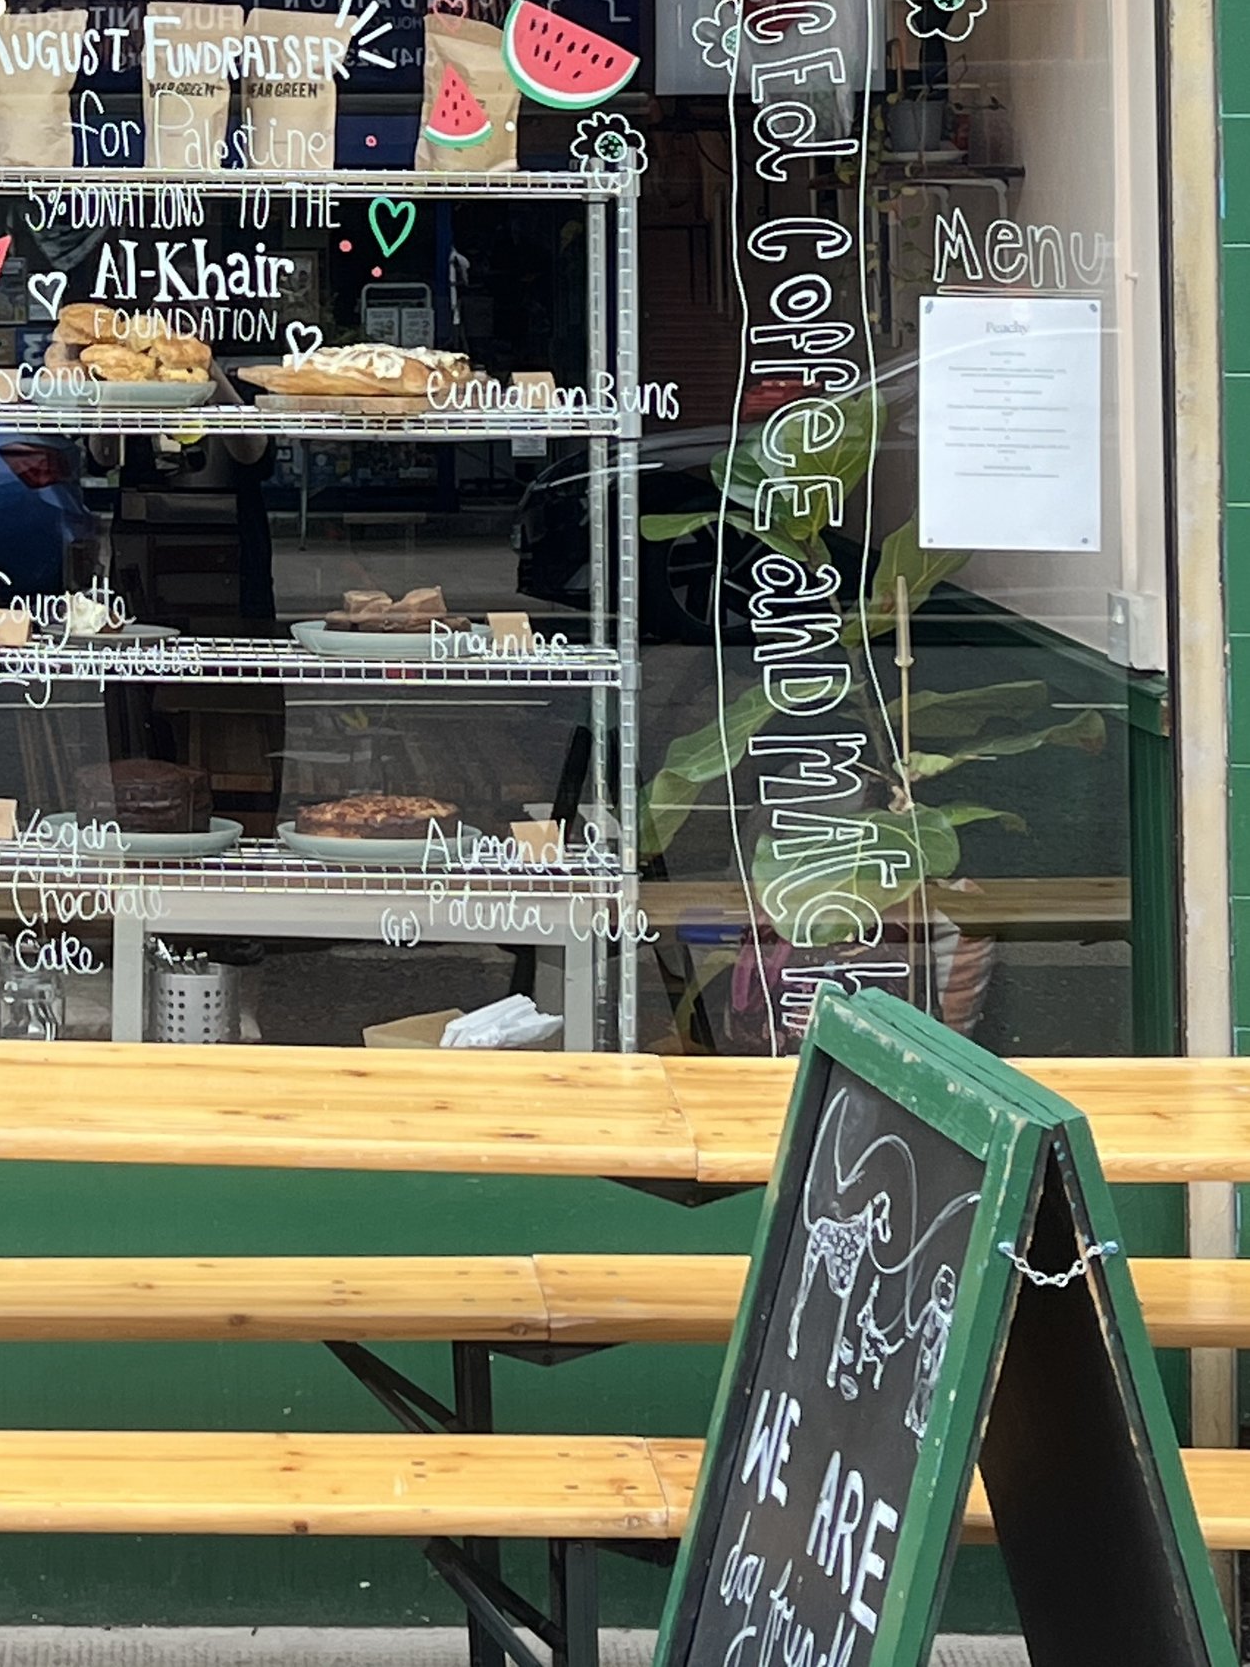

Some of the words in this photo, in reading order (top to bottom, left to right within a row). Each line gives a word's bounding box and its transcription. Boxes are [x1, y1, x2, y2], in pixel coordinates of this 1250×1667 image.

[245, 84, 271, 98] EAR
[63, 90, 141, 167] for
[155, 89, 333, 174] Palestine
[237, 182, 271, 230] TO
[282, 182, 342, 229] THE
[90, 238, 295, 302] Al-Khair
[932, 207, 1105, 289] Menu
[93, 306, 278, 342] FOUNDATION
[426, 370, 588, 416] Cinnamon
[592, 370, 681, 420] Buns
[11, 808, 132, 877] Vegan
[420, 817, 567, 873] Almond
[11, 865, 172, 927] Chocolate
[568, 893, 660, 943] Cake
[15, 928, 104, 975] Cake
[741, 1389, 802, 1508] WE
[806, 1449, 899, 1635] ARE
